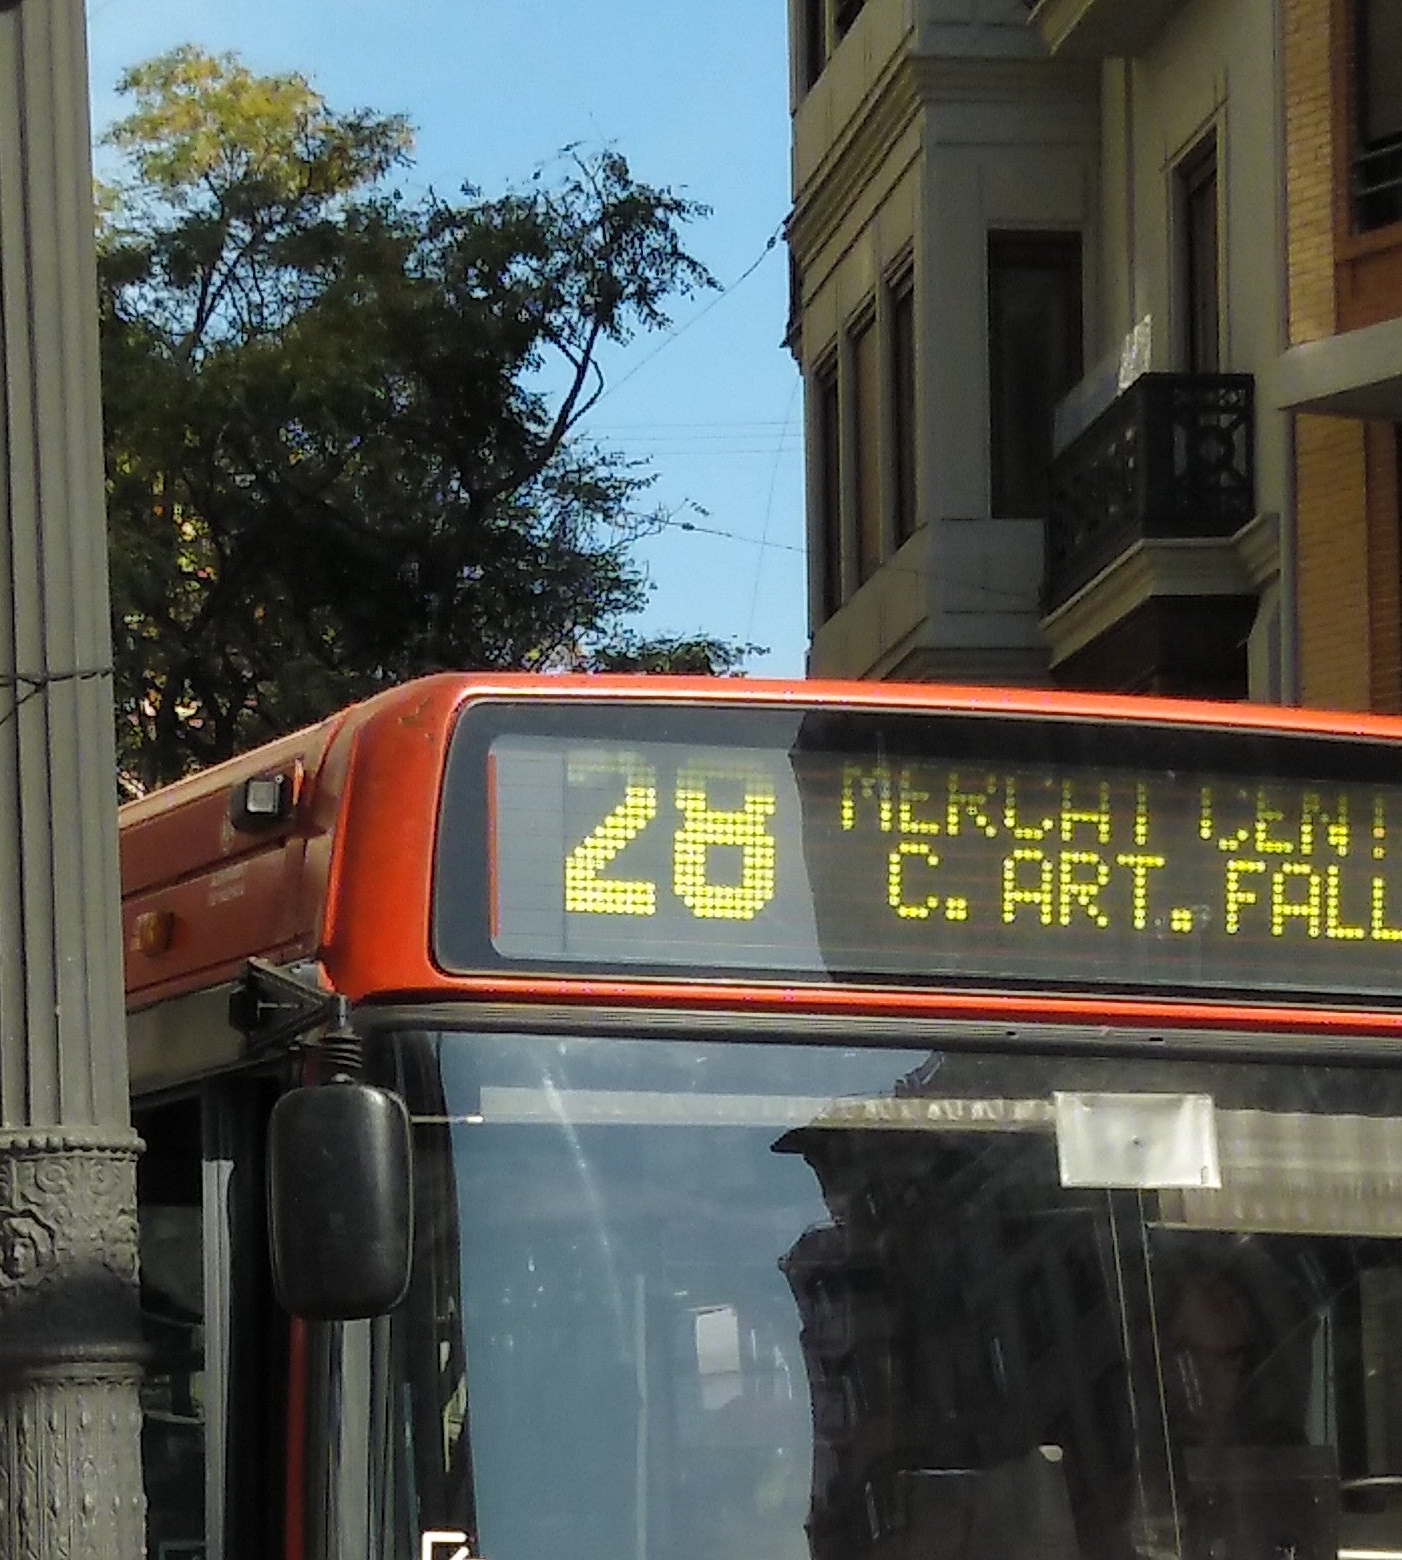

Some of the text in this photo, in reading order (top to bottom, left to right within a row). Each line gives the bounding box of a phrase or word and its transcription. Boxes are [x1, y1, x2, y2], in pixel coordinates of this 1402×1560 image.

[565, 750, 775, 920] 28
[887, 841, 969, 922] C.
[1001, 848, 1192, 933] ART.
